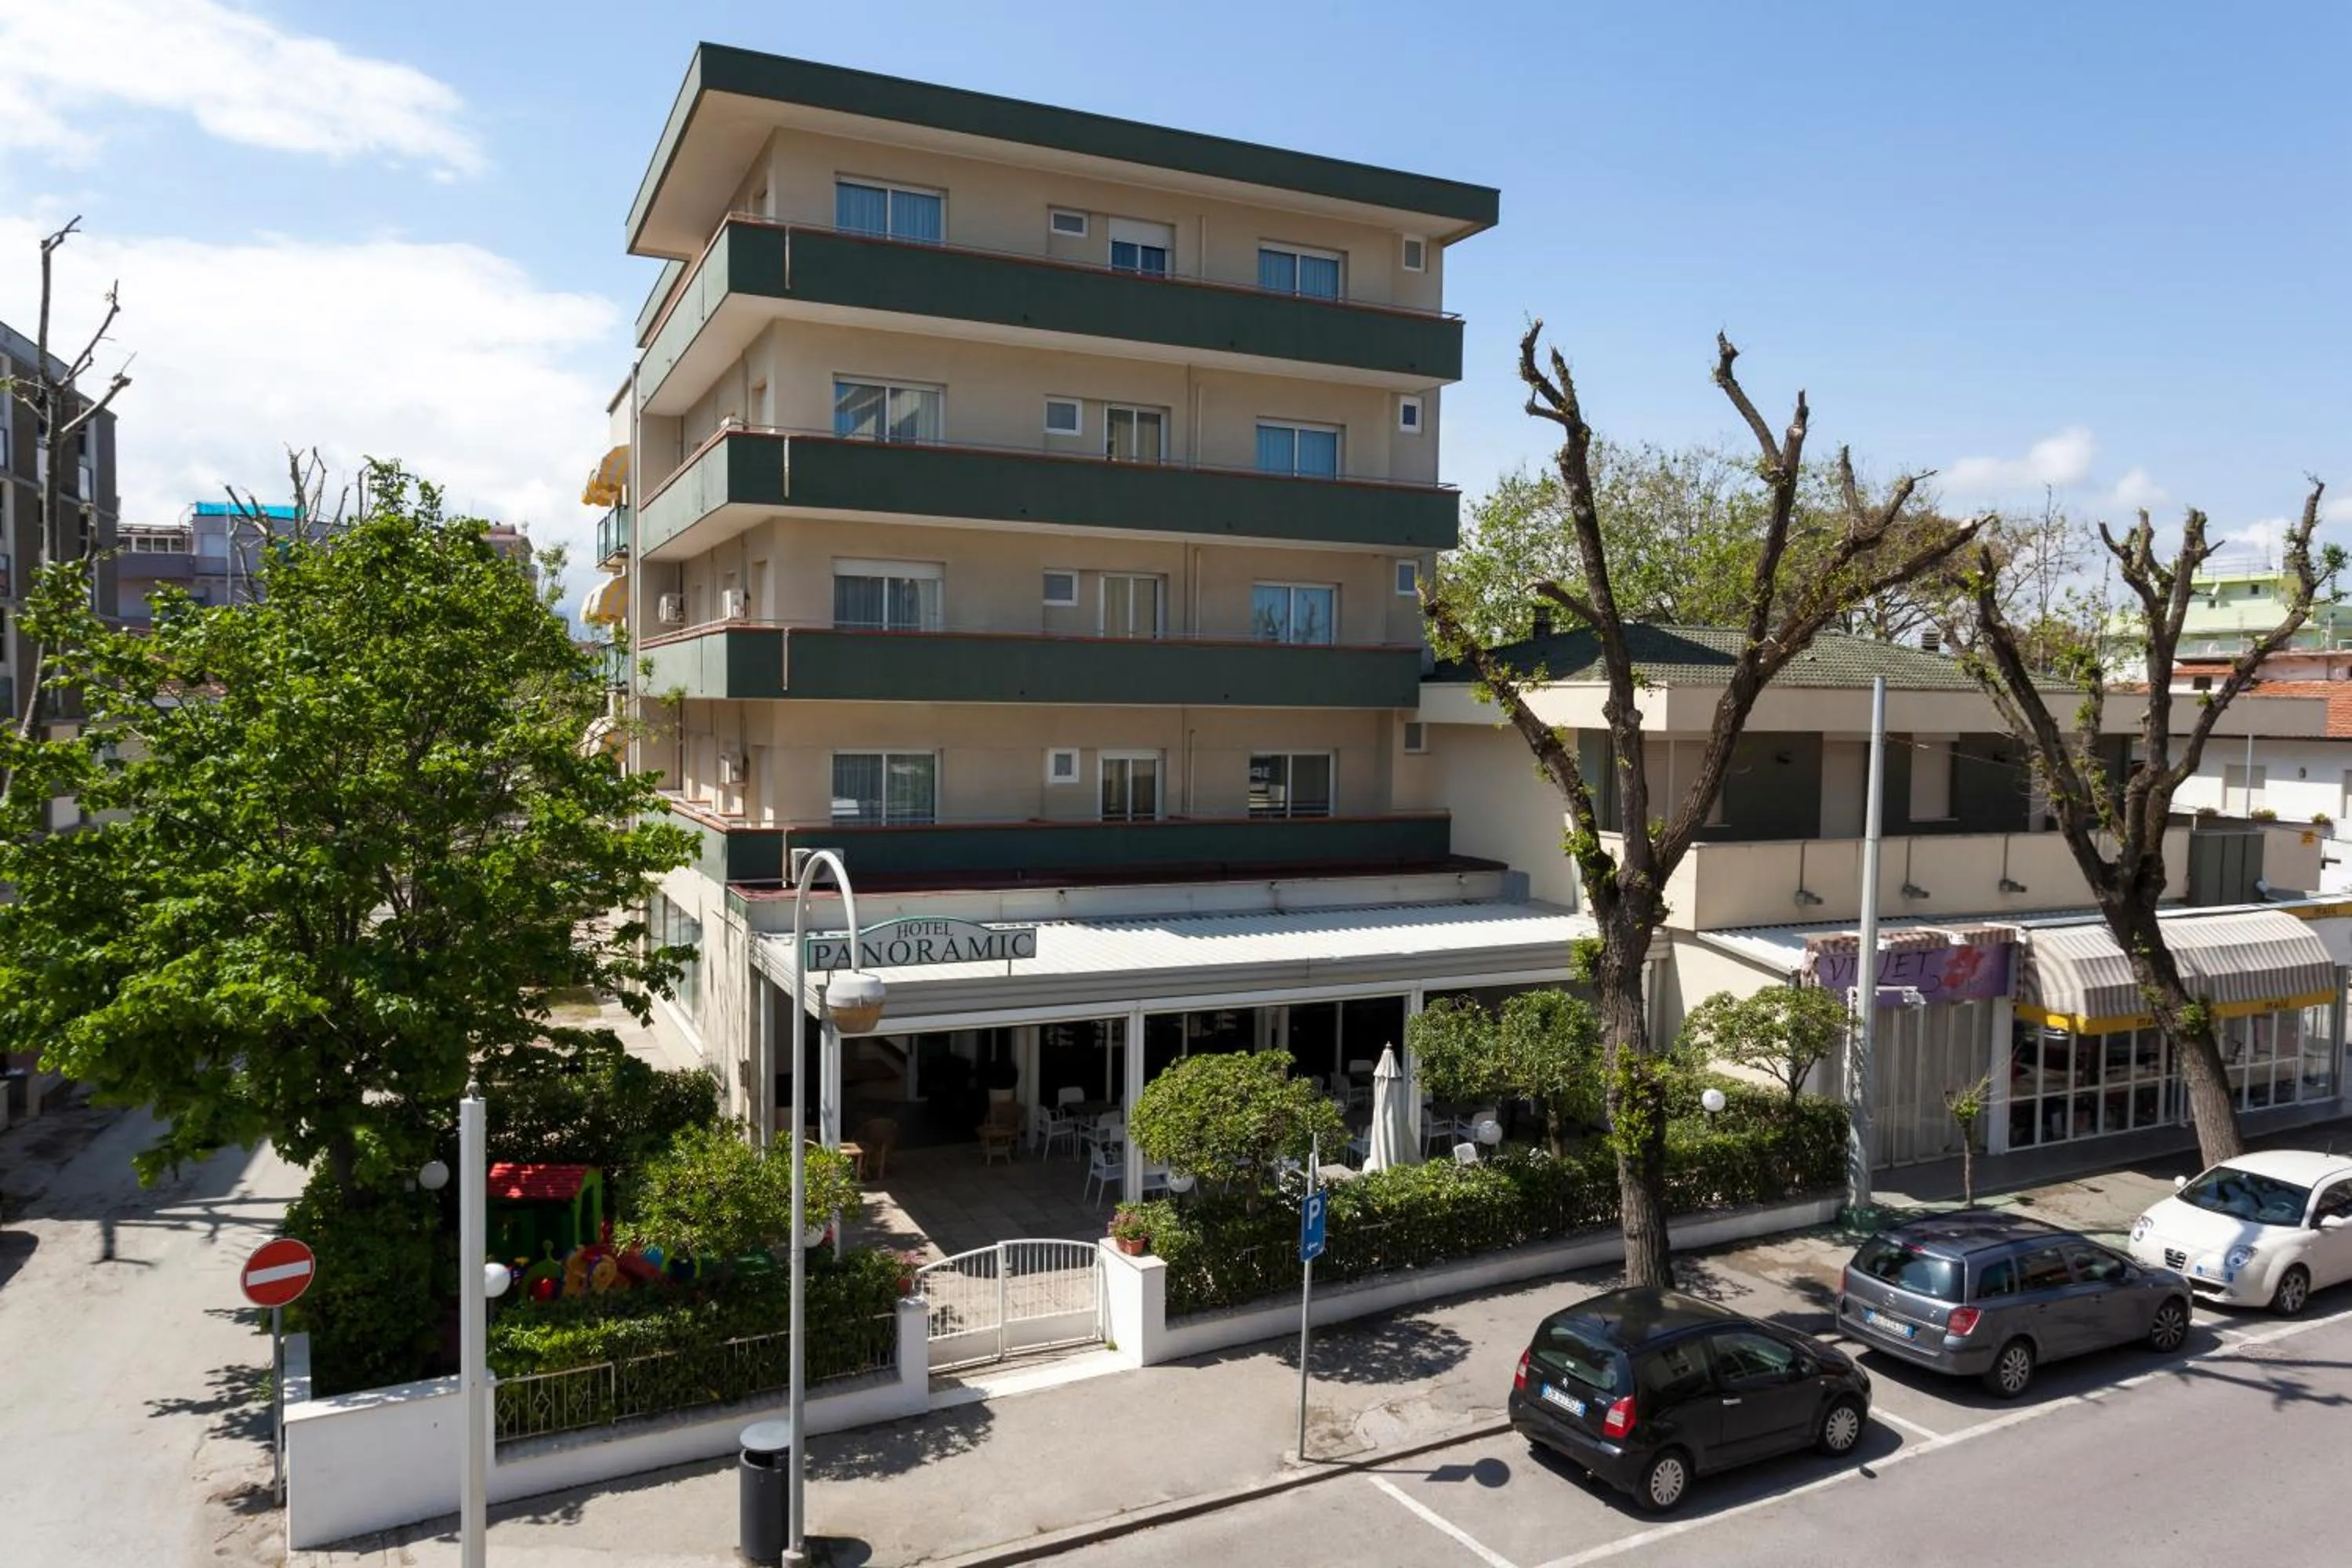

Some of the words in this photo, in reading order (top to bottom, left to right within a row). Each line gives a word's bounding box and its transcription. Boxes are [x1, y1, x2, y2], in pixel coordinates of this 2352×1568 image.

[896, 921, 954, 939] HOTEL
[814, 932, 1034, 969] PANORAMIC
[1828, 949, 1936, 988] VILET
[1307, 1198, 1321, 1230] P
